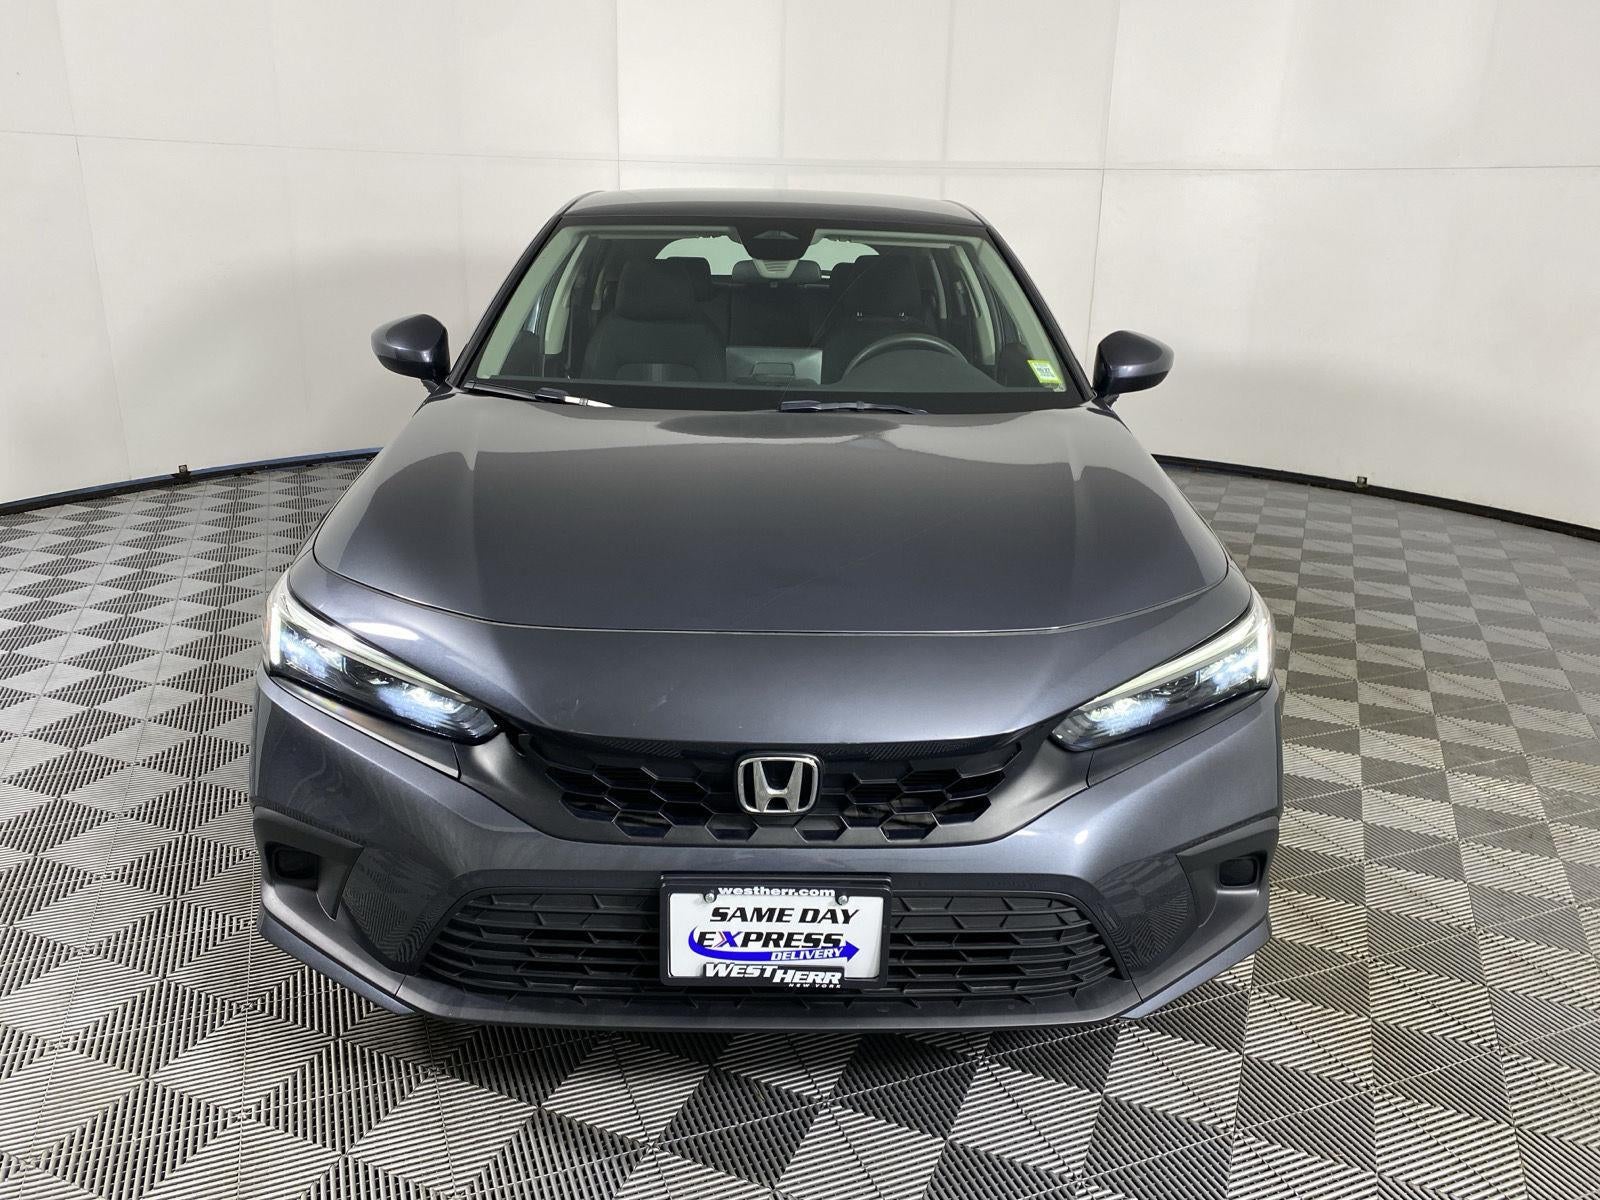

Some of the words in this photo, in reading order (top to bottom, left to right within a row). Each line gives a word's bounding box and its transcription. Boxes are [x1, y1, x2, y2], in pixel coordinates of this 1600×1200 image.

[718, 886, 836, 897] westherr.com
[710, 906, 795, 923] SAME
[799, 908, 860, 925] DAY
[697, 931, 844, 948] EXPRESS
[770, 947, 844, 961] DELIVERY
